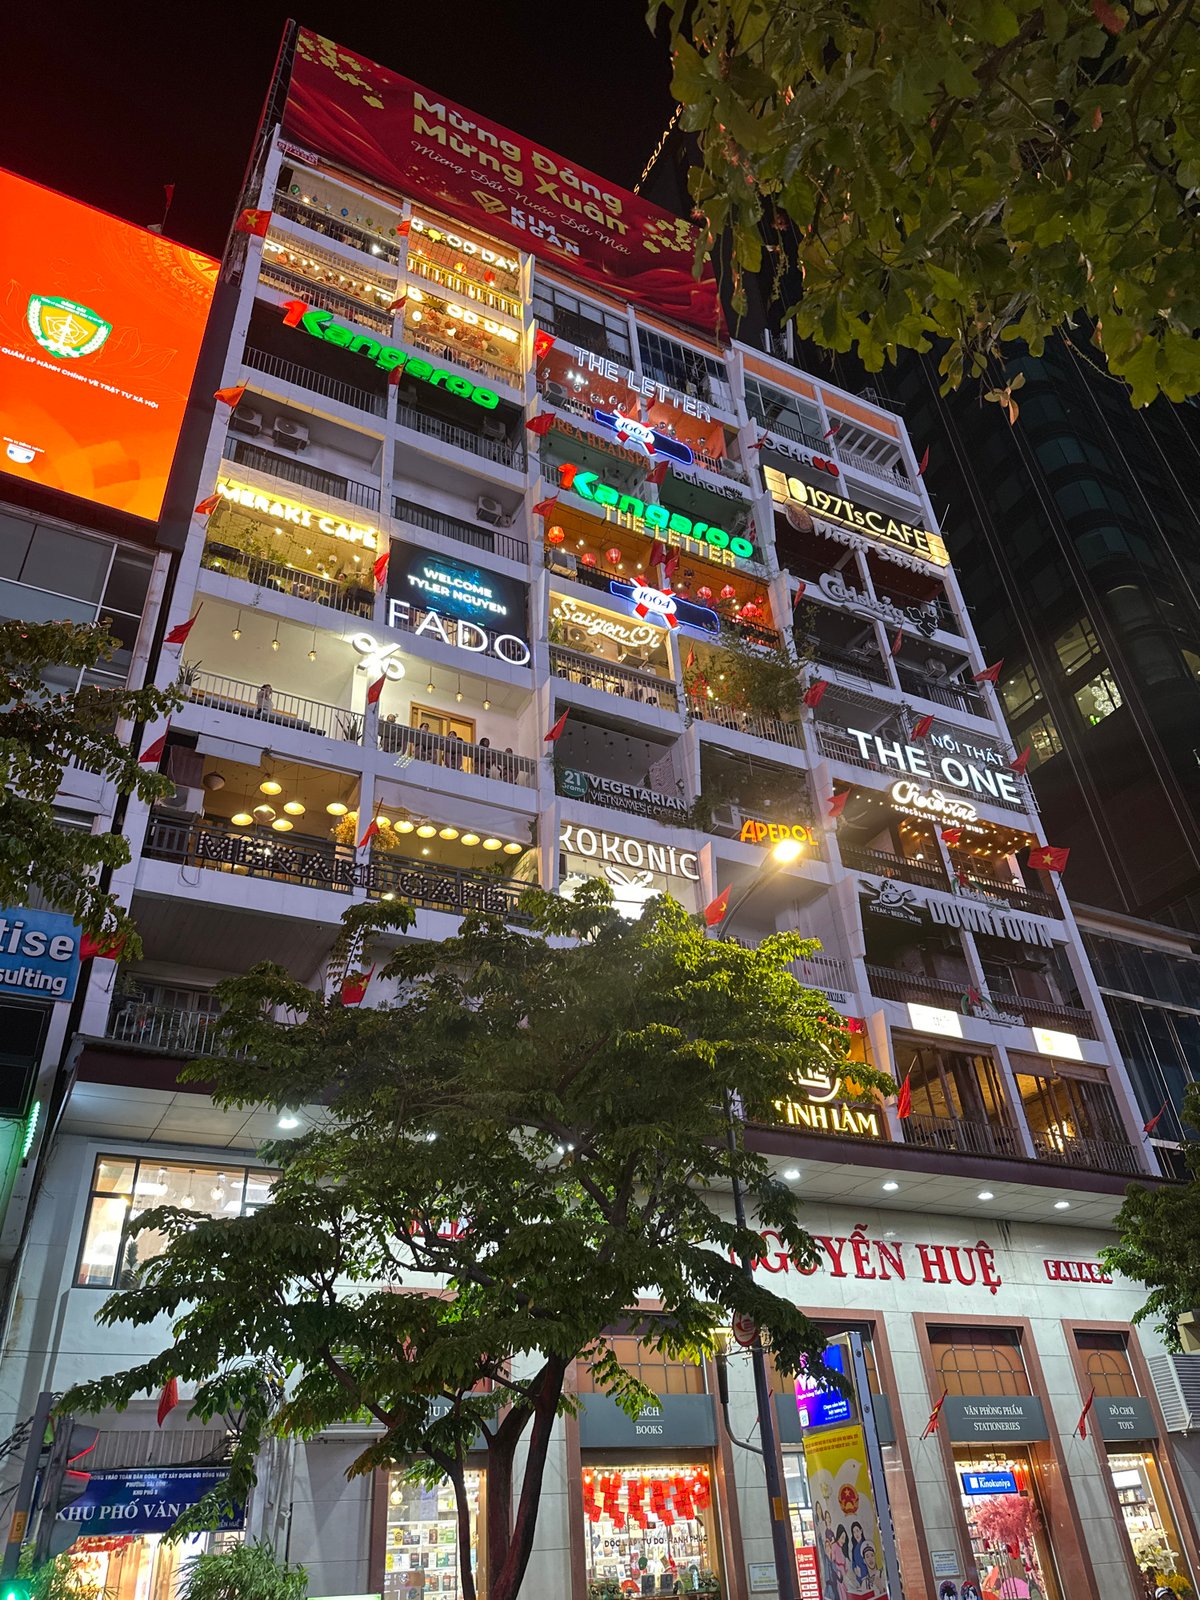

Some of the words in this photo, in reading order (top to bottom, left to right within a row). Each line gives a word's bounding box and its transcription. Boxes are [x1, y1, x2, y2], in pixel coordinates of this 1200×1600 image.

[413, 91, 521, 163] Mừng
[532, 151, 623, 214] Đảng
[413, 114, 524, 187] Mừng
[534, 173, 628, 236] Xuân
[510, 206, 556, 234] KIM
[480, 248, 519, 272] DAY
[302, 311, 500, 410] Kangaroo
[575, 346, 619, 382] THE
[627, 374, 712, 423] LETTER
[620, 421, 650, 439] 1664
[217, 483, 312, 527] MERAKI
[573, 471, 754, 558] Kangaroo
[602, 503, 645, 536] THE
[651, 524, 736, 568] LETTER
[866, 511, 930, 551] CAFE
[407, 574, 450, 597] TYLER
[452, 590, 508, 616] NGUYEN
[423, 566, 493, 598] WELCOME
[639, 591, 671, 609] 1664
[388, 598, 531, 665] FADO
[847, 728, 931, 778] THE
[940, 757, 1022, 804] ONE
[930, 733, 960, 753] NỘI
[962, 741, 1003, 768] THẤT
[563, 769, 581, 786] 21
[589, 774, 688, 812] VEGETARIAN
[195, 830, 376, 888] MERAKI
[926, 898, 1054, 949] DOWNTOWN
[914, 1240, 1002, 1296] HUỆ
[635, 1424, 664, 1436] BOOKS
[964, 1404, 978, 1416] VĂN
[979, 1404, 1003, 1416] PHÒNG
[973, 1421, 1021, 1431] STATIONERIES
[1117, 1421, 1135, 1431] TOYS
[55, 1507, 95, 1521] KHU
[99, 1499, 139, 1520] PHỐ
[143, 1500, 181, 1519] VĂN
